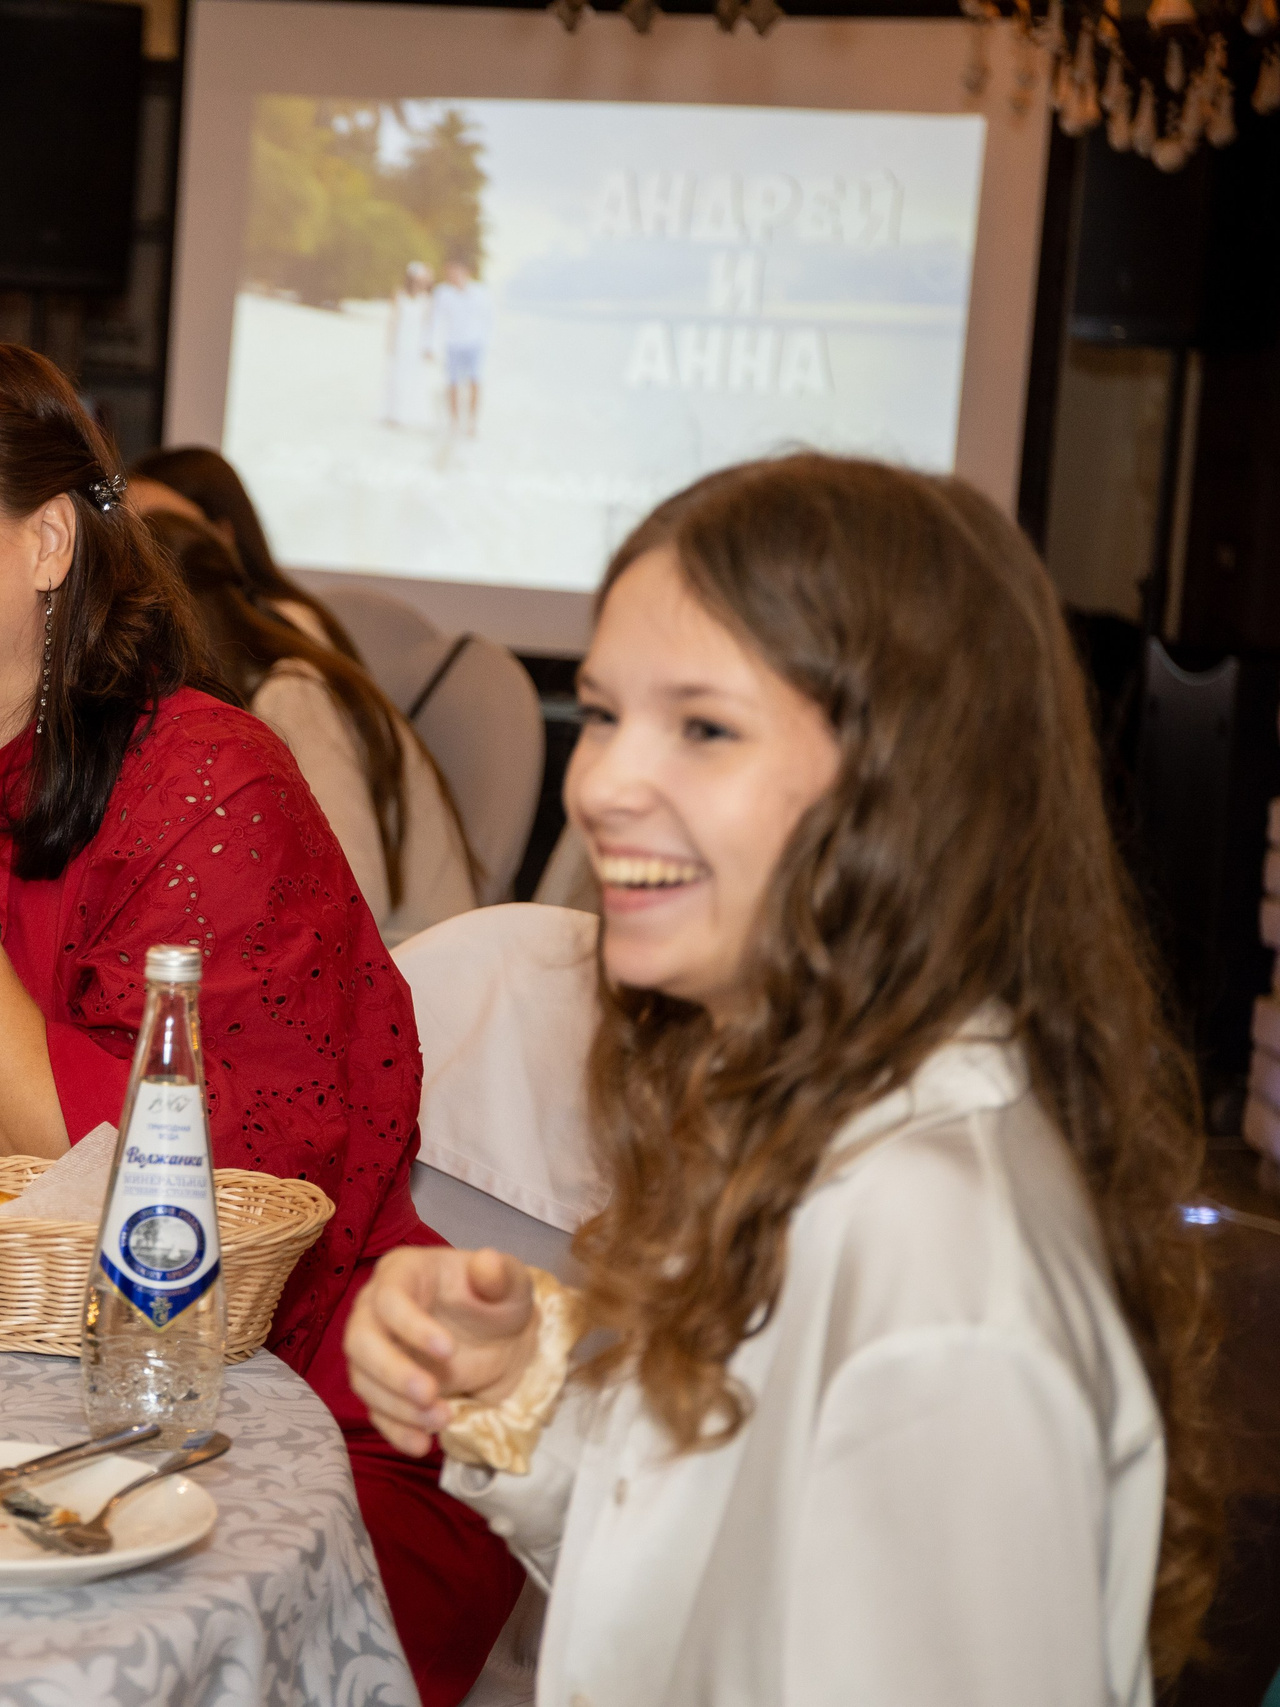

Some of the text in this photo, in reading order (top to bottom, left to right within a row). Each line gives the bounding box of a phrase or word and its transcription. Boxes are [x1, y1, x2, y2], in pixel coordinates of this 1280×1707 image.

[590, 168, 904, 249] АНДРЕЙ
[710, 250, 765, 315] И
[624, 320, 835, 398] АННА
[126, 1146, 203, 1169] Волжанка
